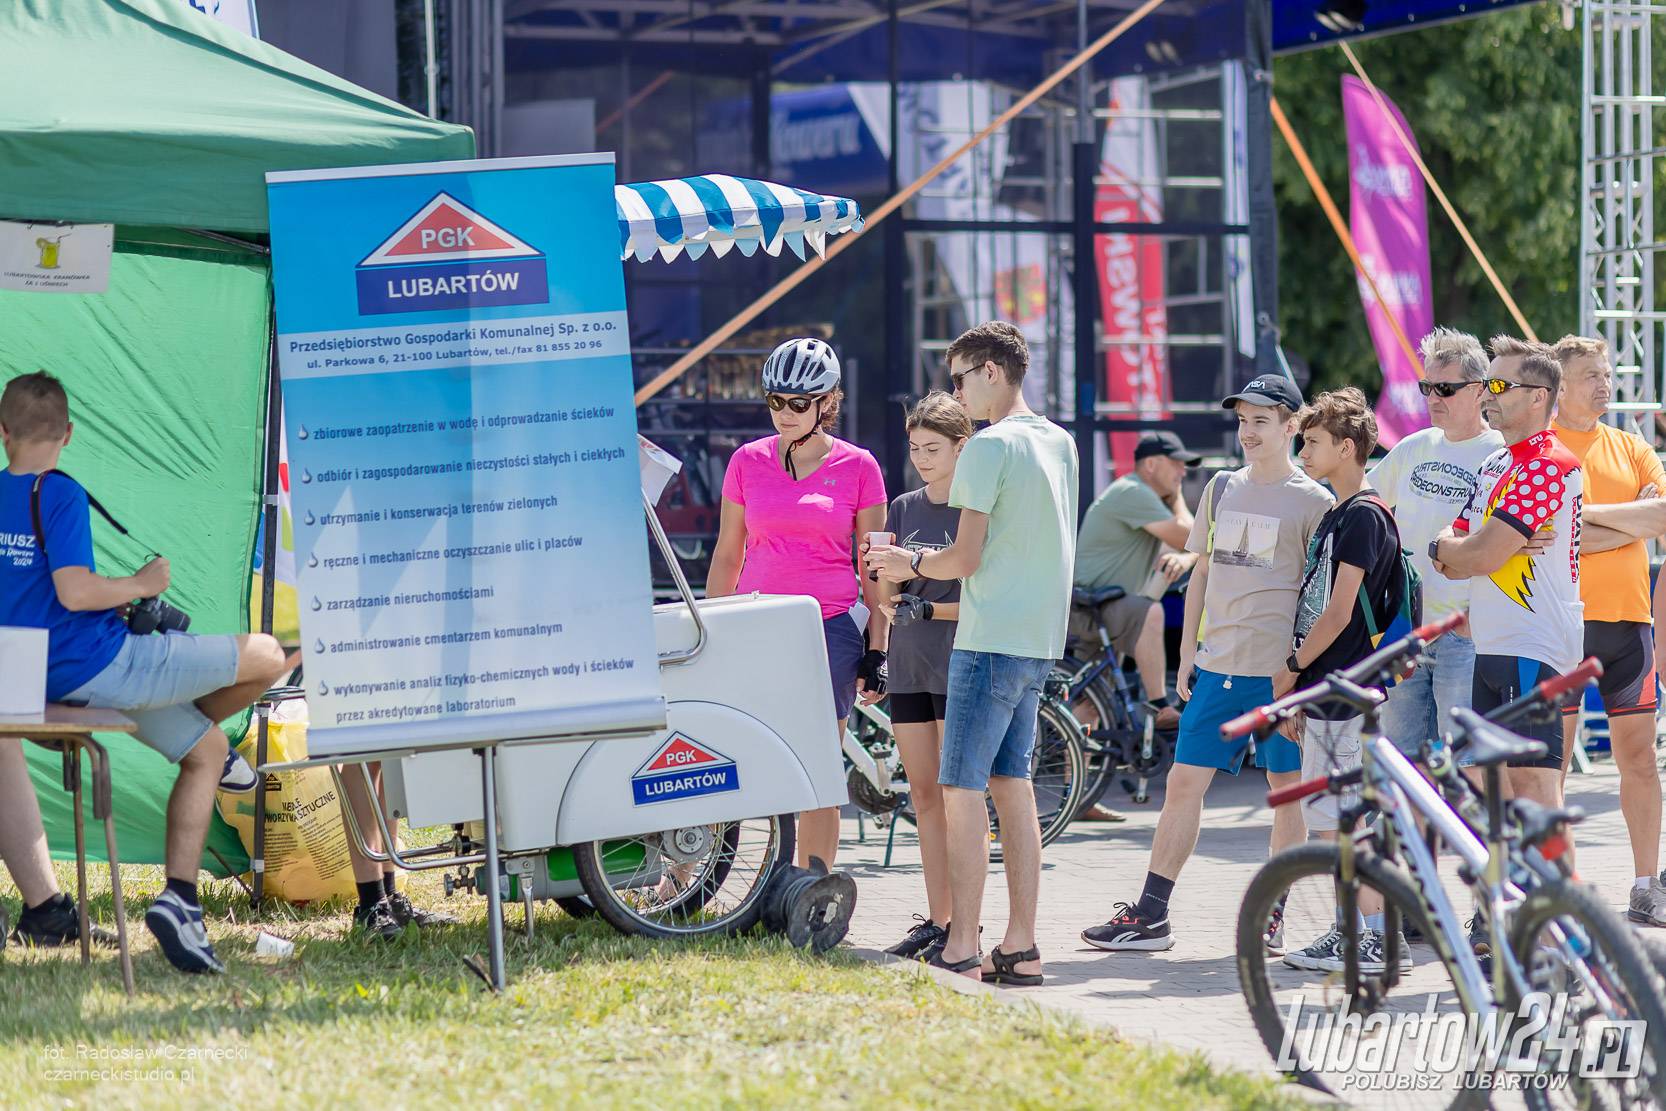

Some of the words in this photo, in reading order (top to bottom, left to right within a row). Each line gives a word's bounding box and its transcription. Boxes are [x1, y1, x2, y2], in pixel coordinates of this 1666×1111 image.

[421, 226, 475, 249] PGK
[388, 270, 519, 298] LUBARTÓW
[290, 335, 402, 353] Przedsiębiorstwo
[405, 328, 476, 346] Gospodarki
[480, 325, 554, 340] Komunalnej
[559, 322, 578, 336] Sp.
[582, 324, 589, 332] z
[593, 322, 616, 331] o.o.
[307, 360, 321, 369] ul.
[325, 356, 374, 368] Parkowa
[378, 355, 388, 365] 6,
[393, 352, 432, 363] 21-100
[436, 347, 492, 360] Lubartów,
[495, 345, 533, 356] tel./fax
[536, 344, 549, 353] 81
[552, 343, 571, 352] 855
[574, 341, 586, 349] 20
[589, 340, 602, 348] 96
[313, 427, 363, 440] zbiorowe
[366, 420, 434, 437] zaopatrzenie
[437, 422, 446, 431] w
[449, 417, 478, 431] wodę
[481, 416, 485, 427] i
[488, 410, 568, 428] odprowadzanie
[571, 405, 614, 420] ścieków
[317, 468, 352, 482] odbiór
[355, 468, 359, 479] i
[362, 460, 463, 481] zagospodarowanie
[466, 455, 530, 472] nieczystości
[533, 450, 571, 467] stałych
[574, 450, 578, 462] i
[581, 447, 625, 463] ciekłych
[320, 509, 380, 526] utrzymanie
[383, 508, 388, 520] i
[391, 504, 458, 520] konserwacja
[462, 500, 504, 514] terenów
[507, 495, 558, 511] zielonych
[324, 555, 359, 570] ręczne
[362, 553, 366, 564] i
[369, 547, 440, 565] mechaniczne
[443, 541, 512, 559] oczyszczanie
[515, 539, 535, 552] ulic
[538, 538, 541, 550] i
[544, 535, 583, 552] placów
[327, 594, 390, 611] zarządzanie
[394, 585, 494, 605] nieruchomościami
[330, 635, 421, 653] administrowanie
[424, 631, 491, 646] cmentarzem
[494, 623, 563, 639] komunalnym
[334, 679, 406, 697] wykonywanie
[410, 675, 442, 690] analiz
[445, 665, 549, 688] fizyko-chemicznych
[552, 662, 580, 677] wody
[583, 661, 587, 672] i
[590, 657, 634, 673] ścieków
[336, 710, 364, 725] przez
[368, 704, 443, 720] akredytowane
[446, 695, 516, 713] laboratorium
[666, 749, 697, 765] PGK
[645, 772, 727, 796] LUBARTÓW
[296, 790, 336, 820] SZTUCZNE
